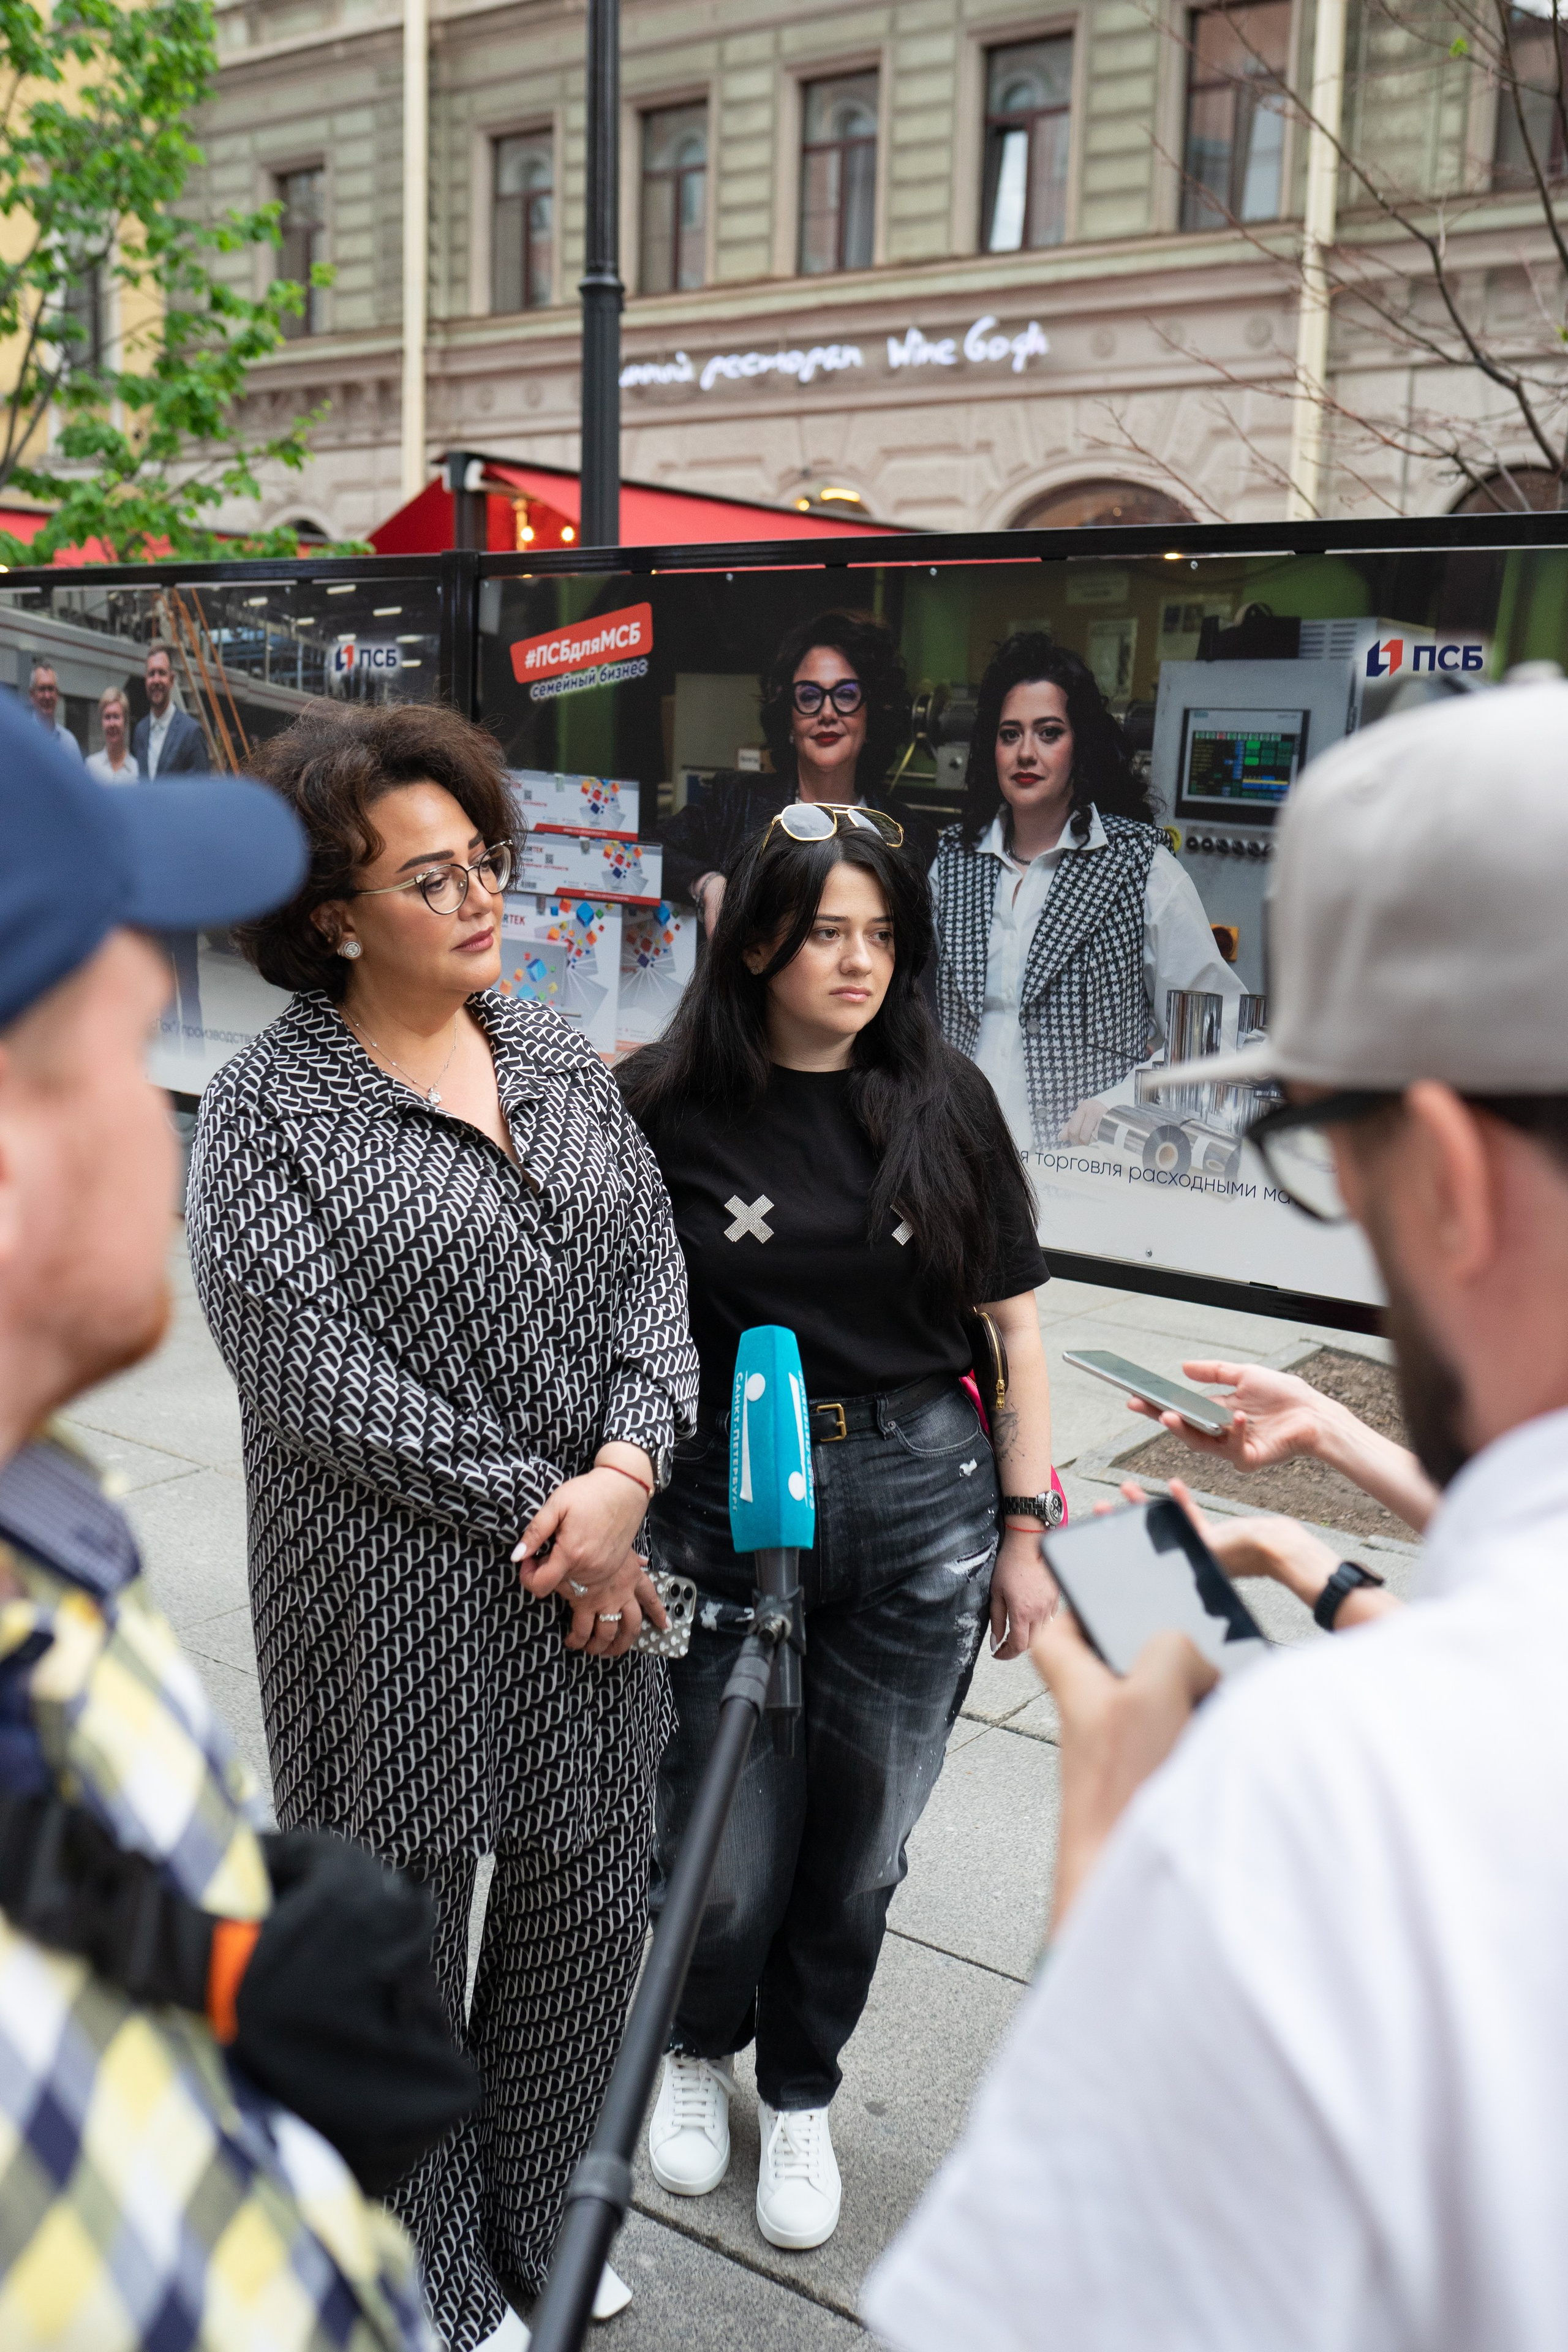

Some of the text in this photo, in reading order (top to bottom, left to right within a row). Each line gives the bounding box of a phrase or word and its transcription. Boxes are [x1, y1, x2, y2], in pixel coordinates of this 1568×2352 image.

[360, 649, 397, 668] ПСБ
[524, 622, 641, 669] #ПСБдляМСБ
[1412, 645, 1483, 671] ПСБ
[532, 660, 647, 699] семейный бизнес
[1036, 1152, 1121, 1177] торговля
[1129, 1166, 1256, 1198] расходными
